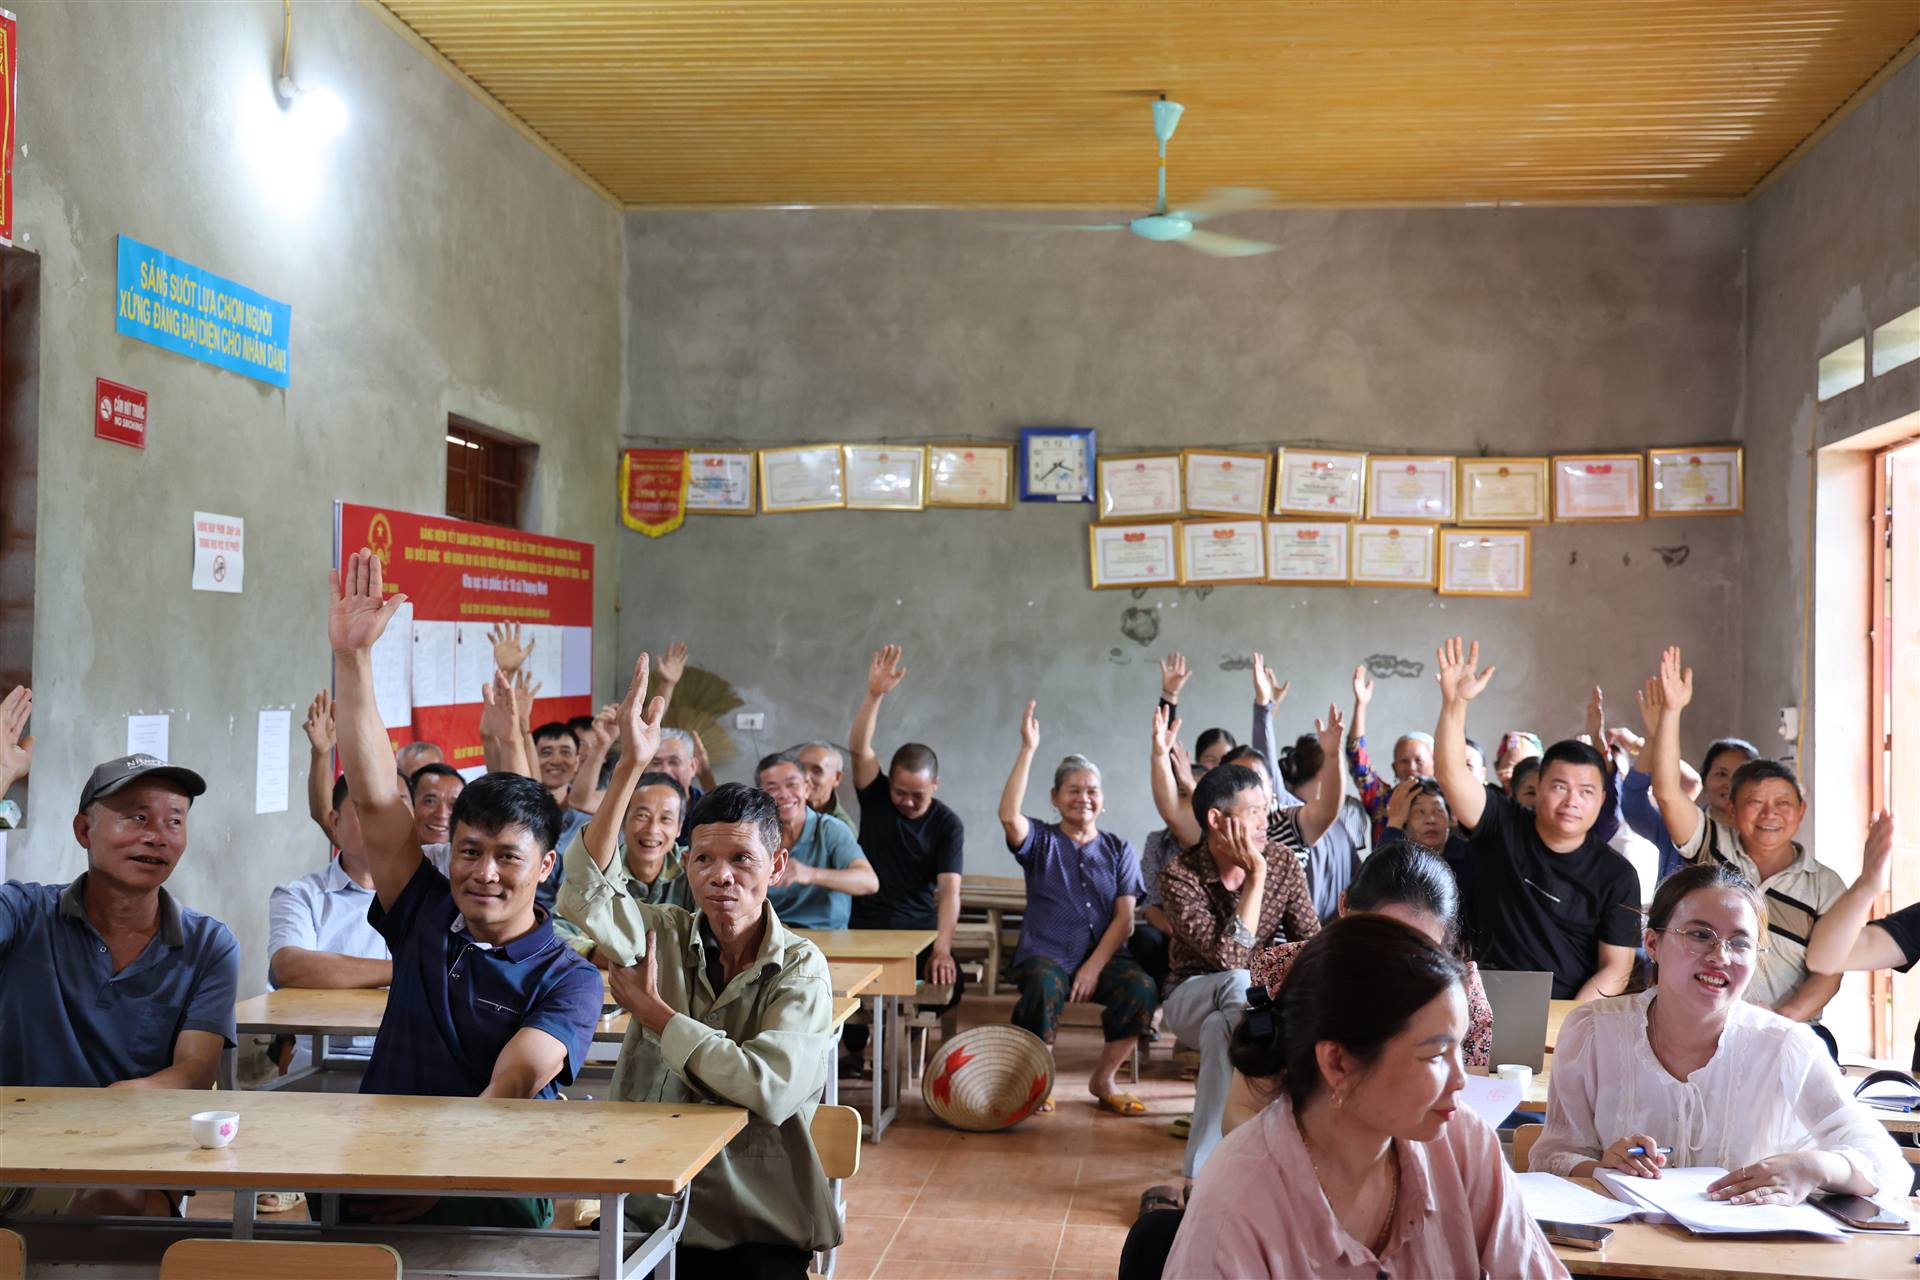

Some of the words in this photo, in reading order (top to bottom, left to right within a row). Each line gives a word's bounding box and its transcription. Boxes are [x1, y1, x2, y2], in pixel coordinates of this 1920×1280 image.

[119, 285, 151, 326] XỨNG
[221, 327, 242, 358] CHO
[140, 258, 168, 297] SÁNG
[217, 292, 245, 330] CHỌN
